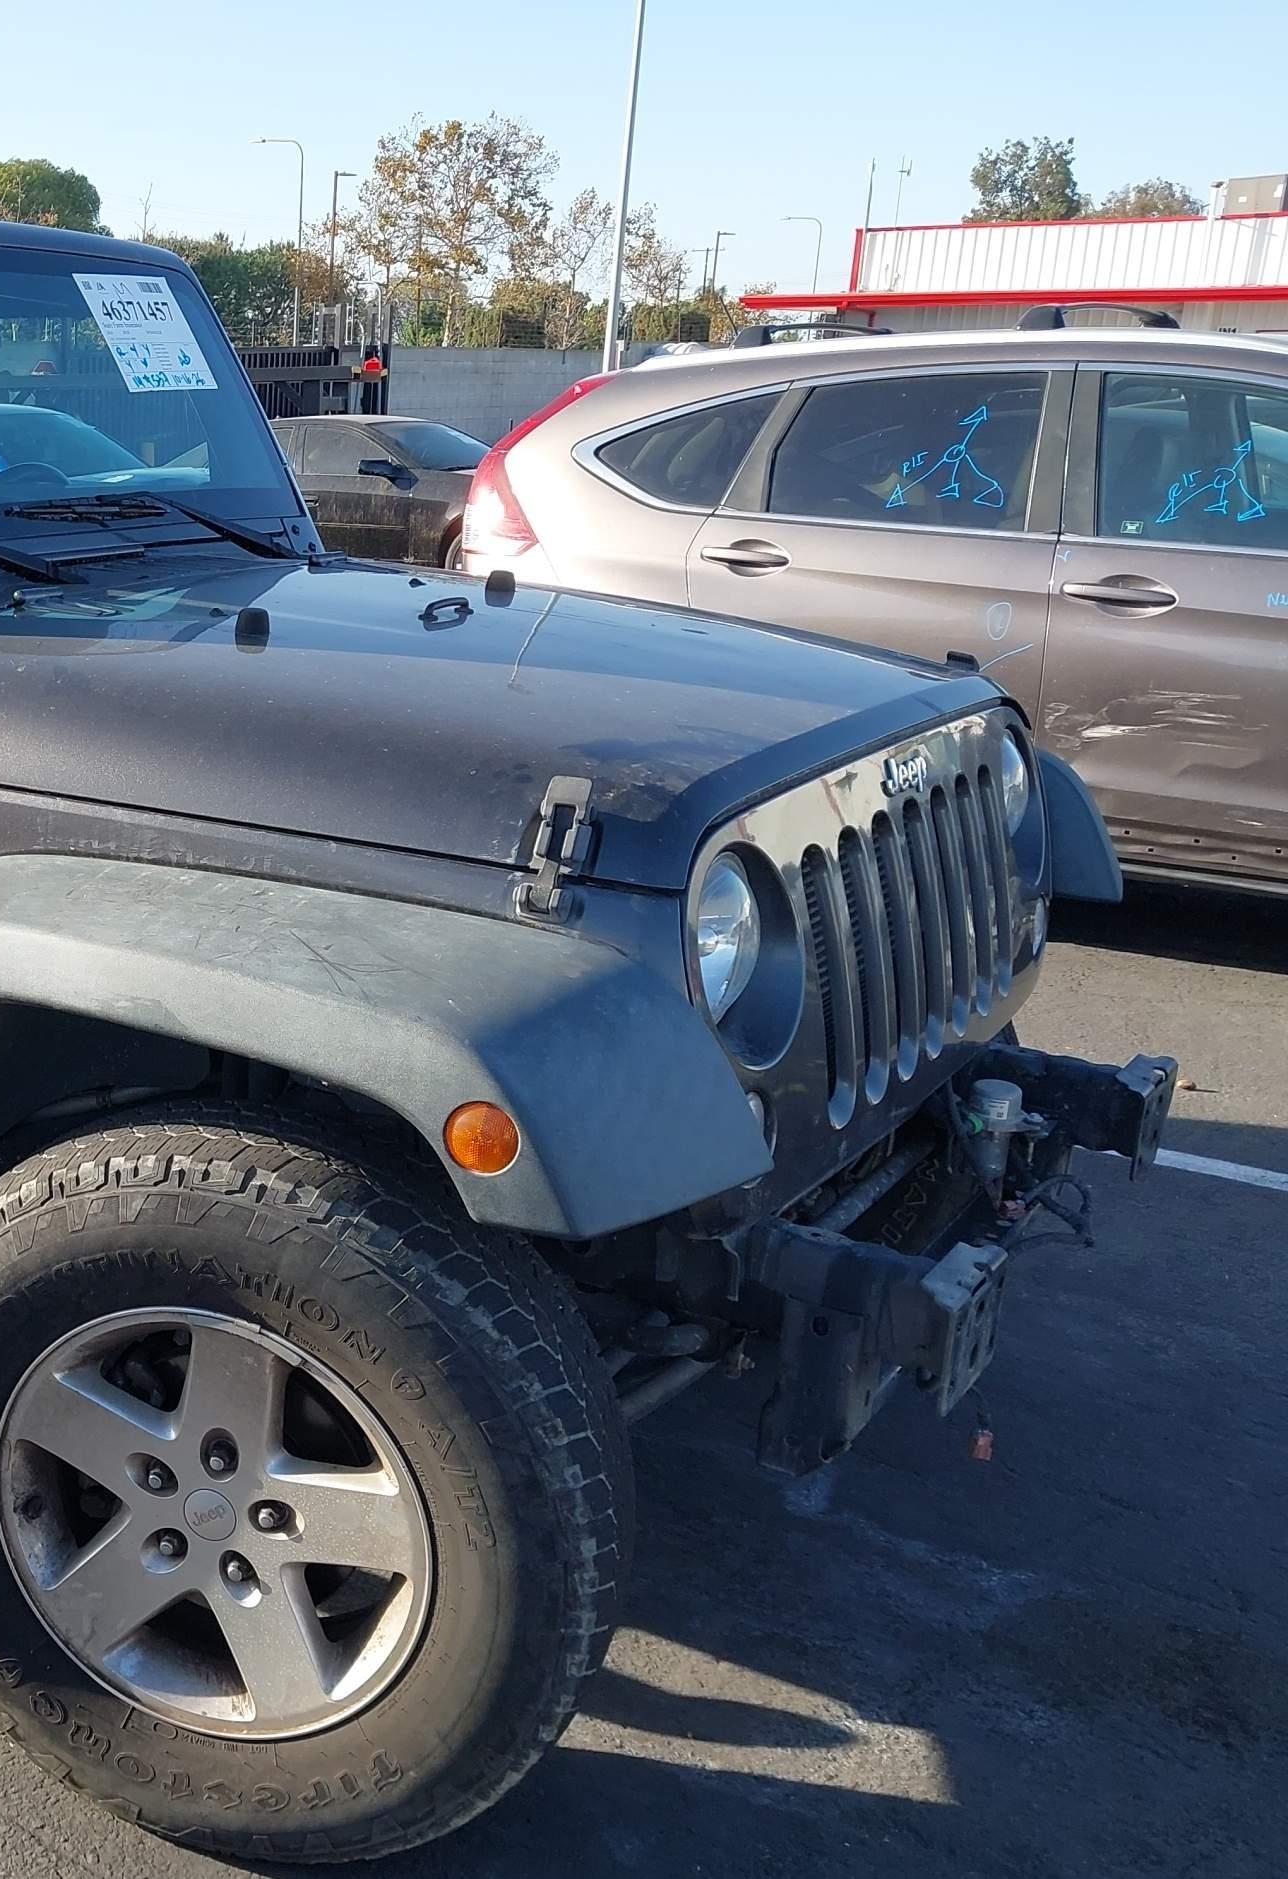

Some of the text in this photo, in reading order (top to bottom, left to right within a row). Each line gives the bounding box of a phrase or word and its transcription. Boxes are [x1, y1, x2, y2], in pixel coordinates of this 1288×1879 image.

[101, 300, 174, 321] 46371457
[880, 755, 928, 798] Jeep
[192, 1504, 227, 1527] Jeep
[28, 1689, 404, 1813] Firestone
